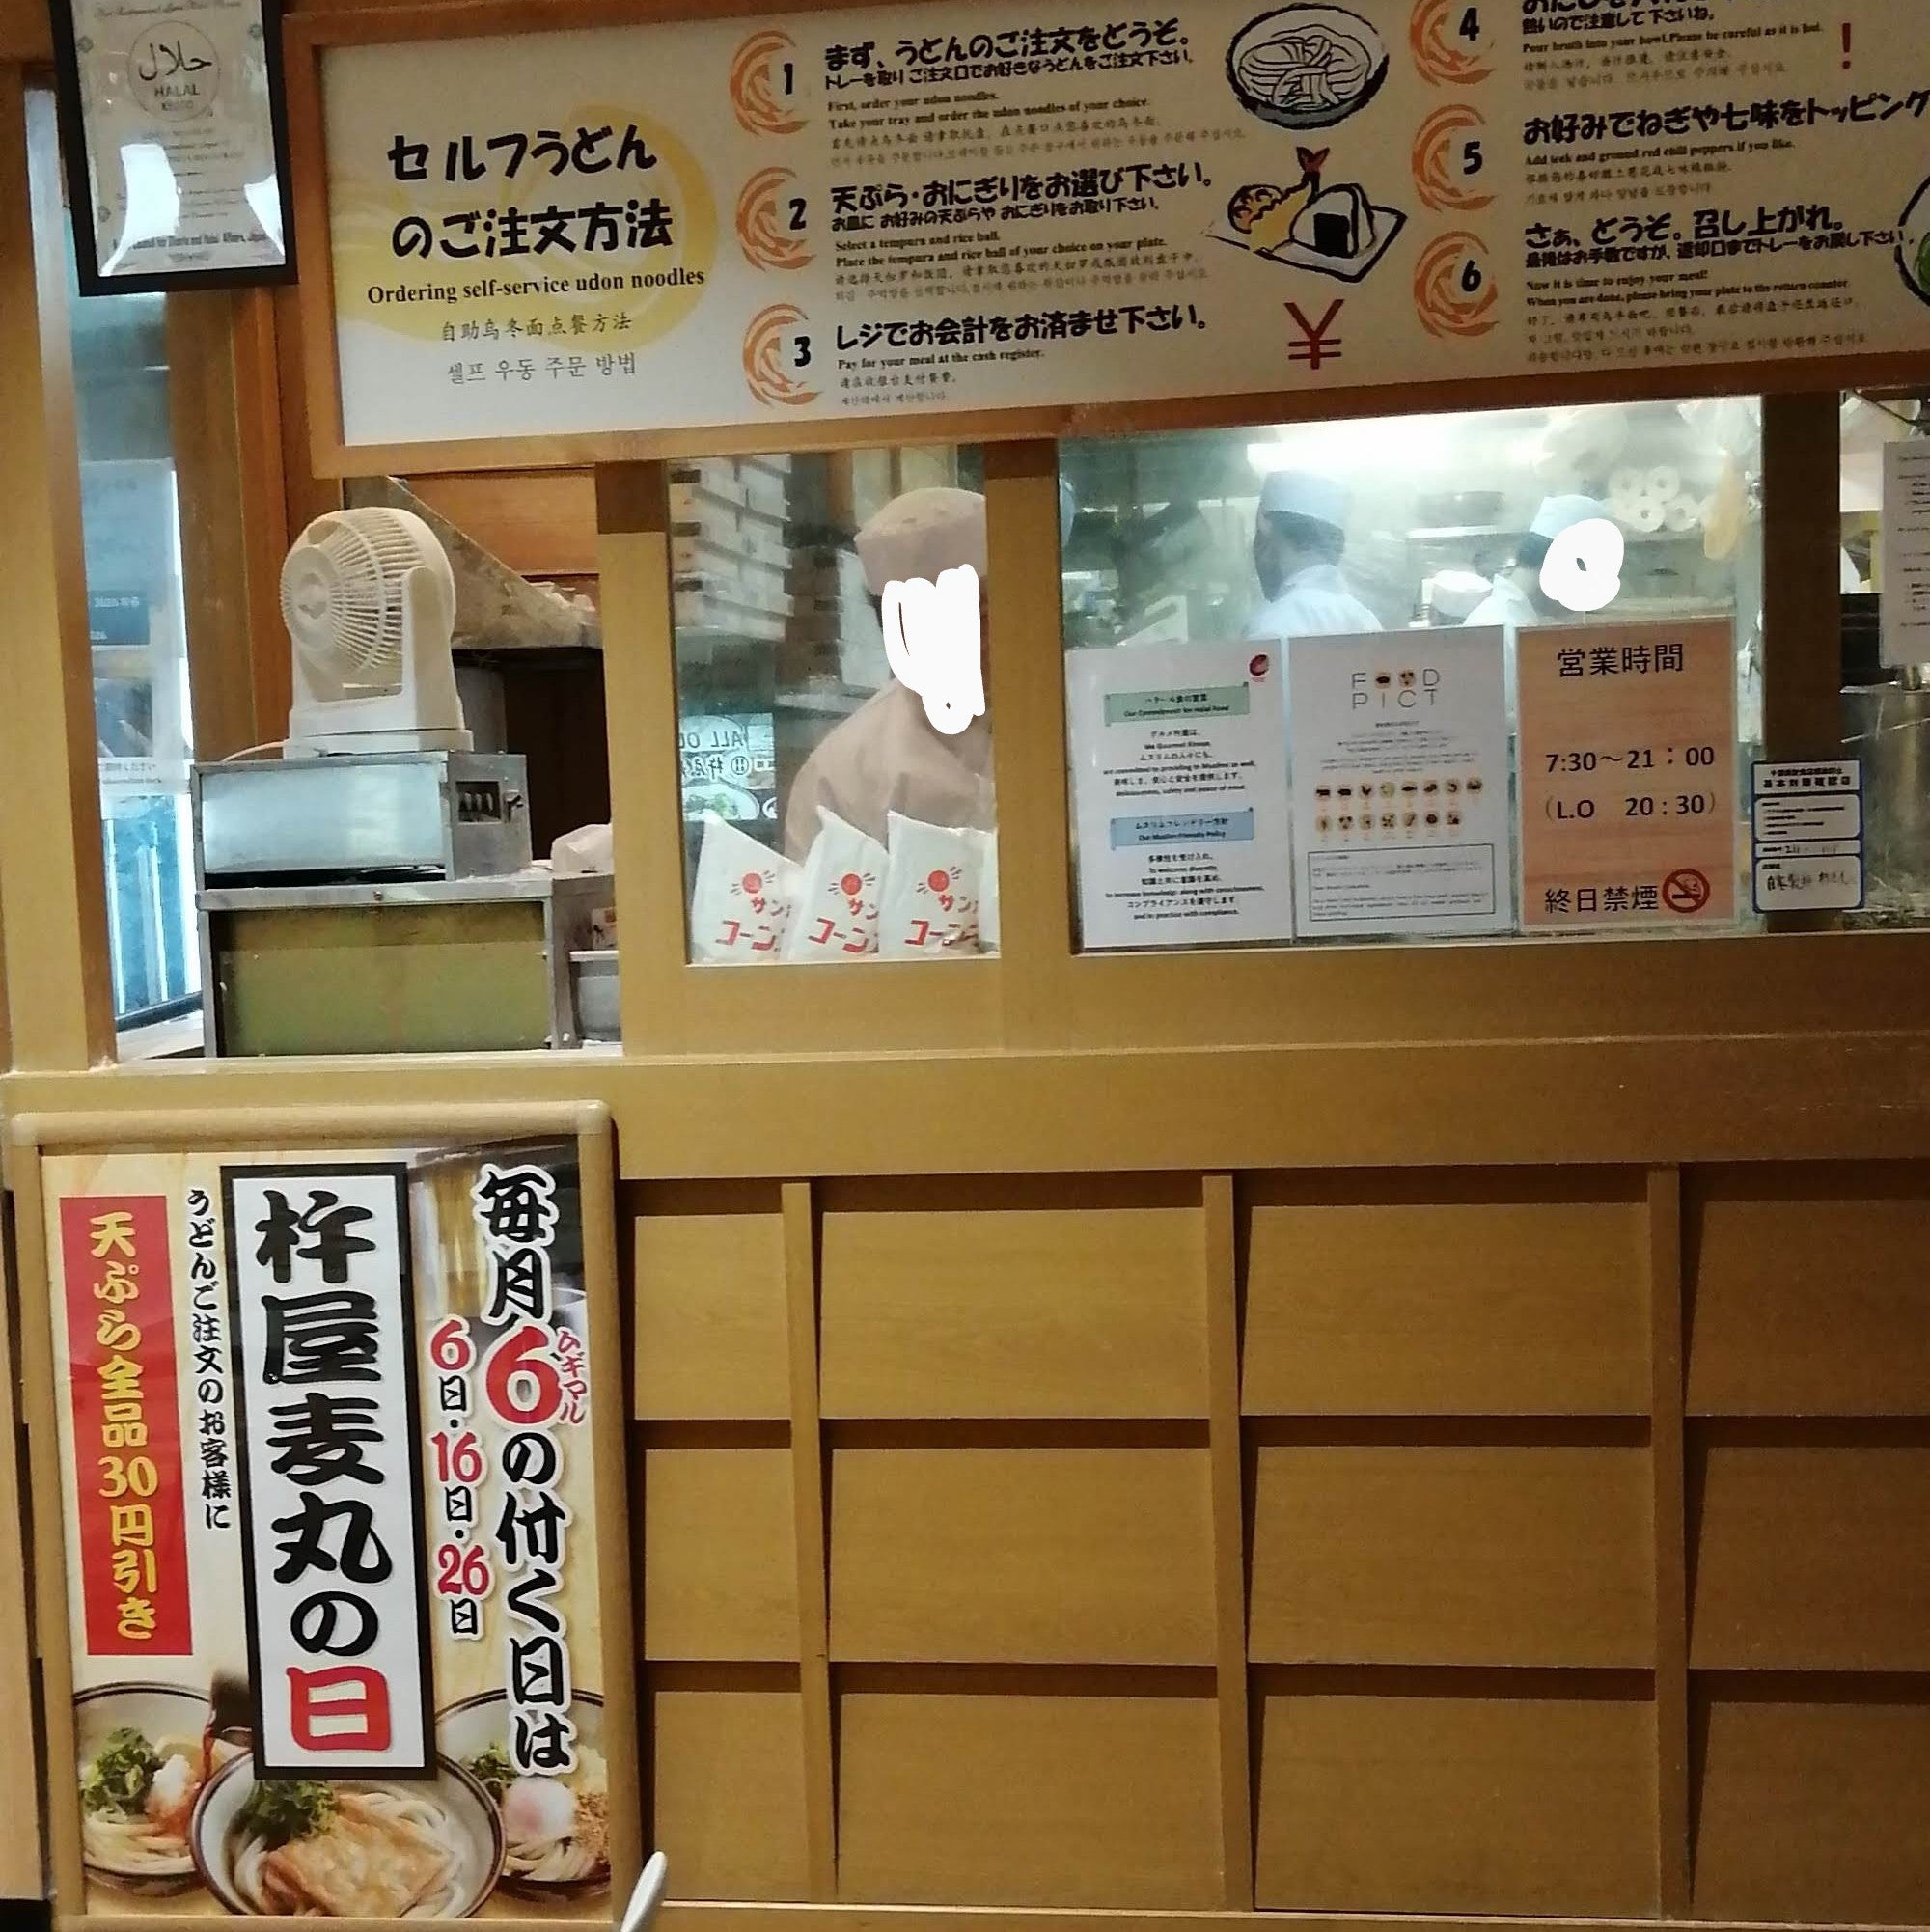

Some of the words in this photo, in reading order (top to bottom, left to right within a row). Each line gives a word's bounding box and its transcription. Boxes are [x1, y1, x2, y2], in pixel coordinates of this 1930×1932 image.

[1458, 8, 1480, 41] 4
[139, 40, 212, 81] حلال
[1523, 42, 1548, 52] Pour
[1611, 38, 1636, 49] your
[782, 63, 794, 95] 1
[829, 117, 857, 128] Take
[861, 118, 885, 129] your
[889, 117, 910, 127] tray
[915, 112, 935, 123] and
[938, 110, 968, 121] order
[973, 110, 989, 119] the
[1083, 101, 1108, 113] your
[895, 98, 919, 109] your
[387, 124, 657, 182] セルフうどん
[1463, 141, 1483, 175] 5
[1526, 153, 1548, 165] Add
[1575, 152, 1596, 162] and
[1642, 147, 1661, 157] red
[1748, 142, 1769, 153] you
[392, 198, 673, 259] のご注文方法
[788, 198, 807, 231] 2
[836, 237, 867, 251] Select
[929, 234, 950, 245] and
[952, 234, 974, 243] rice
[836, 257, 864, 267] Place
[868, 255, 884, 265] the
[937, 250, 958, 262] and
[961, 251, 982, 260] rice
[1024, 246, 1049, 258] your
[368, 283, 457, 306] Ordering
[463, 275, 569, 298] self-service
[576, 270, 624, 291] udon
[631, 267, 705, 289] noodles
[1460, 260, 1482, 292] 6
[1527, 280, 1549, 290] Now
[1649, 273, 1674, 285] your
[1527, 296, 1556, 306] When
[1558, 297, 1577, 308] you
[1626, 291, 1657, 304] please
[1690, 289, 1713, 300] your
[837, 304, 1206, 351] レジでお会計をお済ませ下さい。
[447, 361, 487, 385] 셀프
[494, 358, 537, 382] 우동
[545, 355, 588, 379] 주문
[595, 351, 637, 377] 방법
[793, 335, 813, 368] 3
[838, 358, 857, 371] Pay
[880, 358, 905, 370] your
[909, 355, 935, 366] meal
[952, 352, 969, 363] the
[972, 351, 997, 361] cash
[1558, 643, 1684, 677] 営業時間
[1352, 689, 1438, 710] PICT
[1544, 884, 1659, 914] 終日禁煙
[186, 1188, 233, 1531] うどんご注文のお客様に
[89, 1209, 159, 1642] 天ぷら全品30円引き
[254, 1188, 394, 1754] 杵屋麦丸の日
